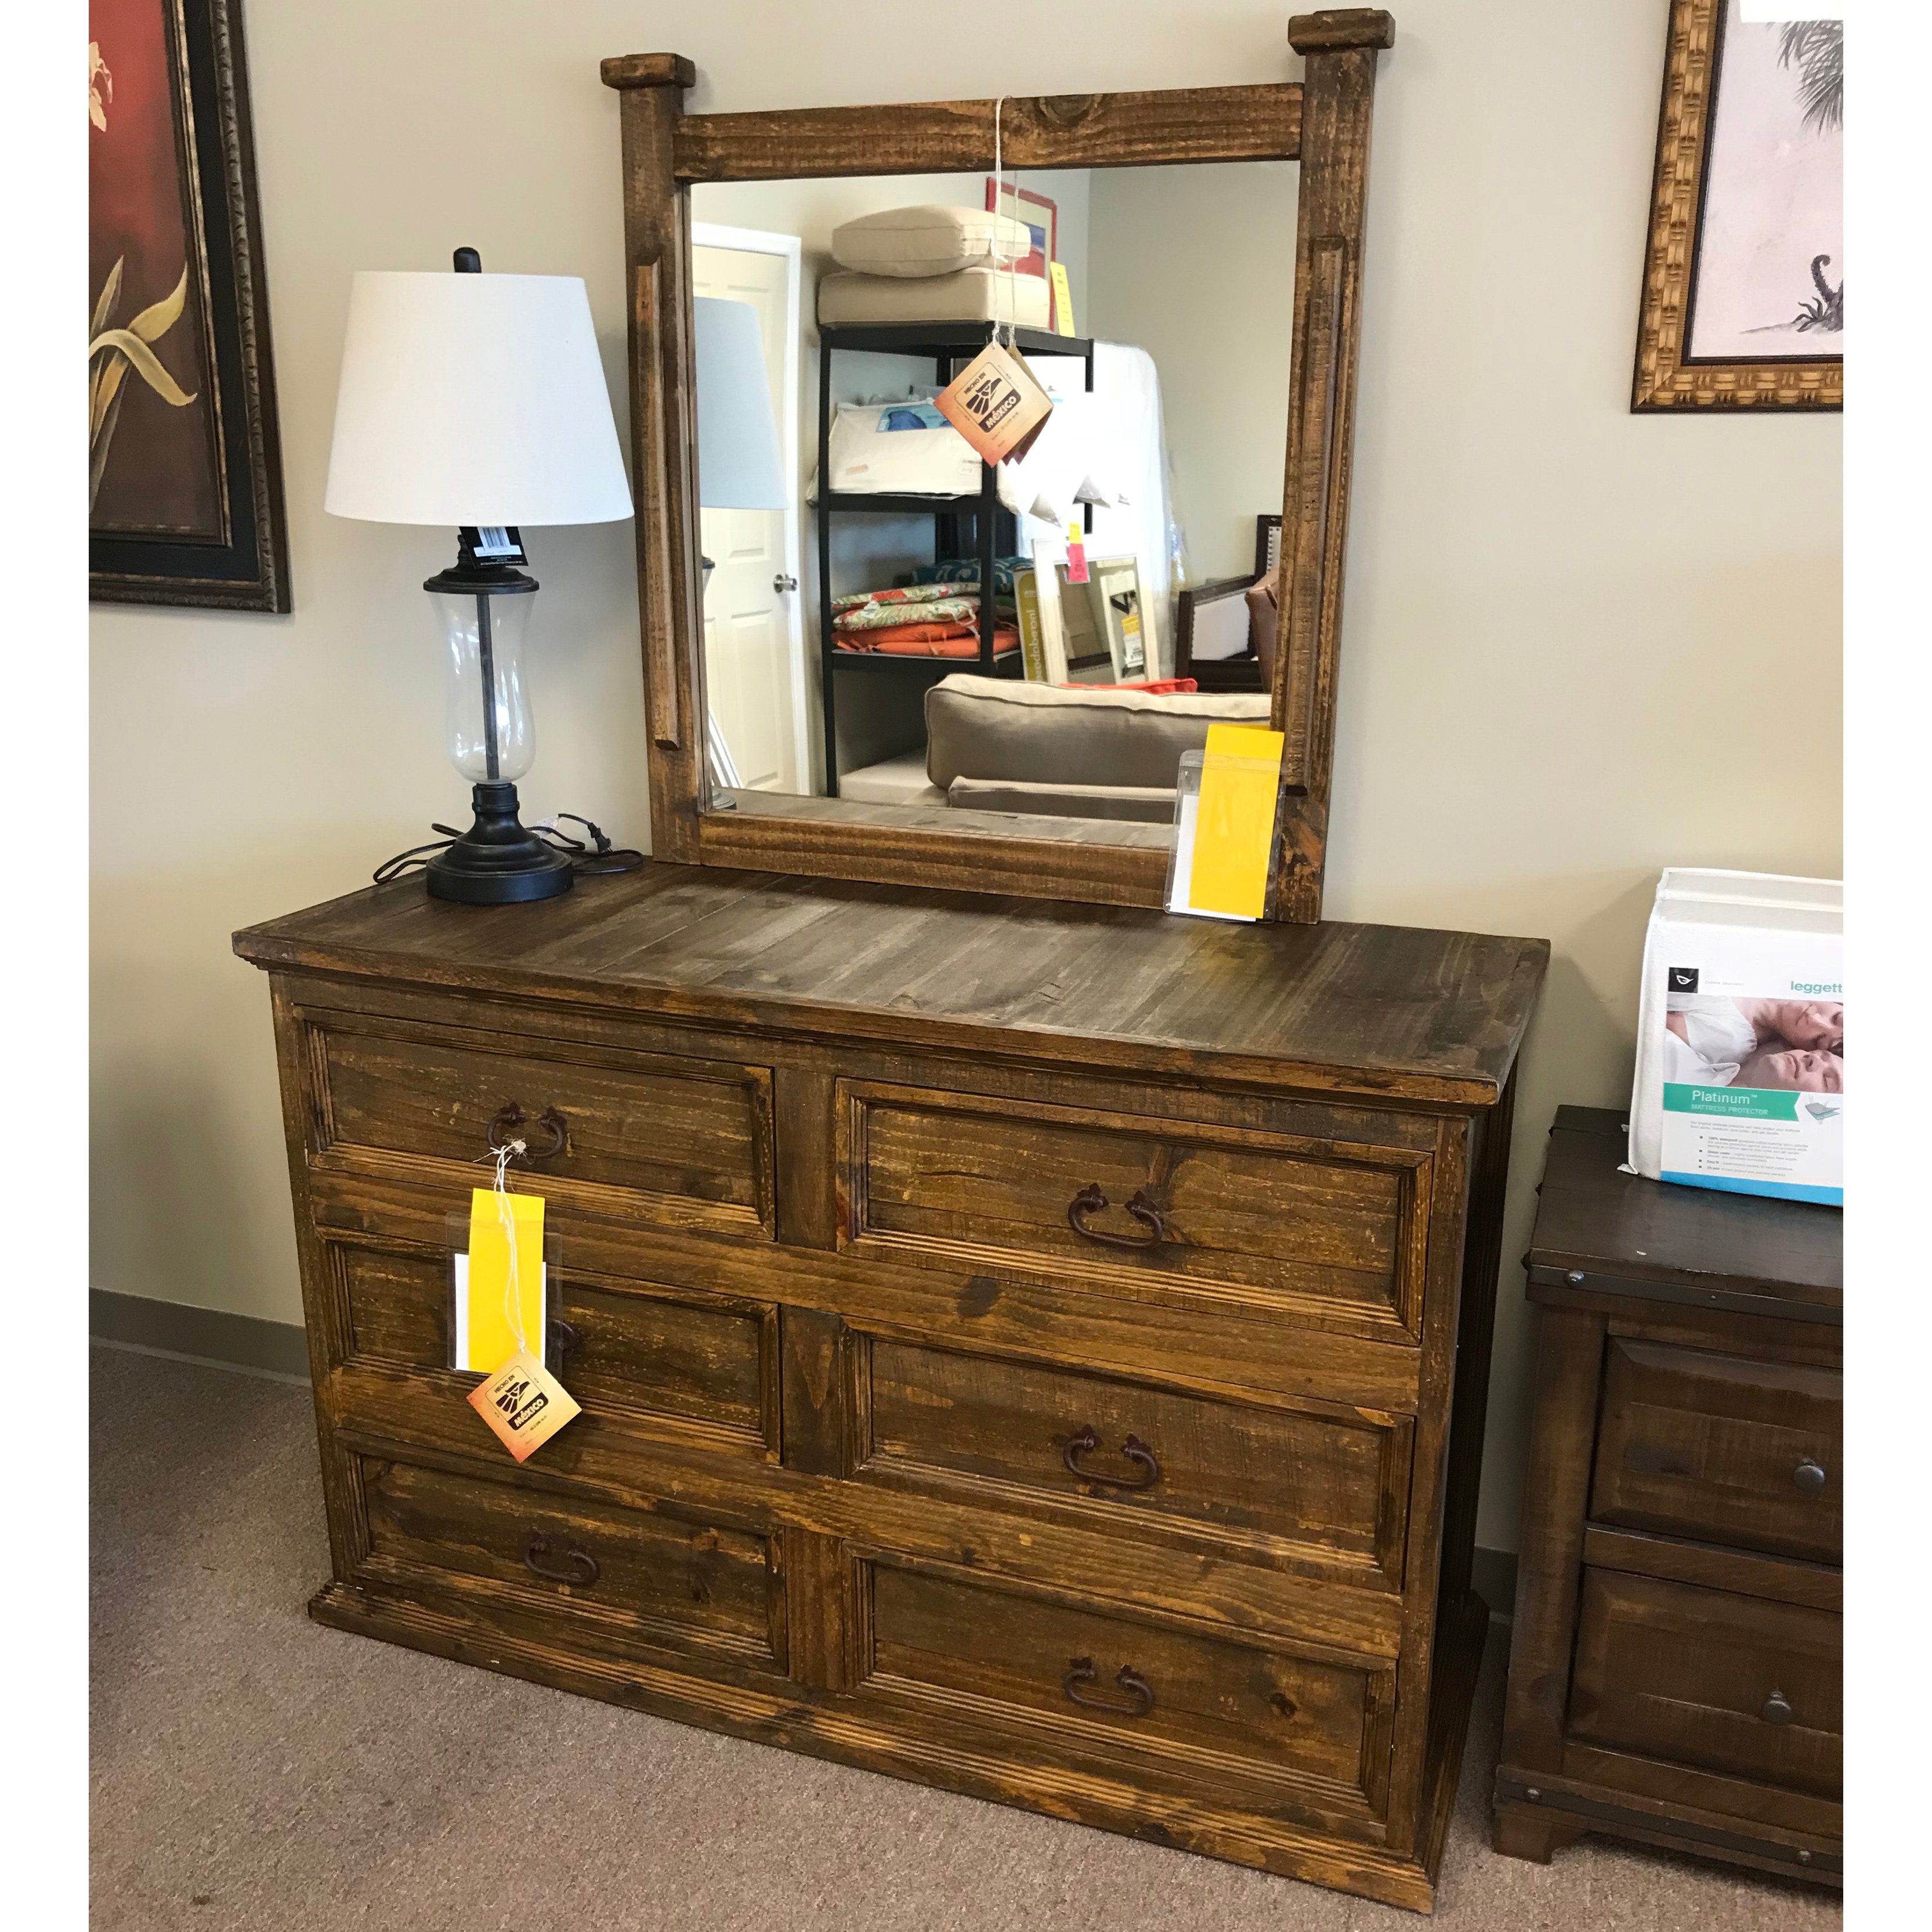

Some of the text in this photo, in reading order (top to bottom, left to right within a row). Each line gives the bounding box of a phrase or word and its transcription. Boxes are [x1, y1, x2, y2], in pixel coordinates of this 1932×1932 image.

[1790, 981, 1843, 994] leggett
[1691, 1104, 1768, 1115] MATTRESS PROTECTOR
[494, 1380, 509, 1394] HECHO
